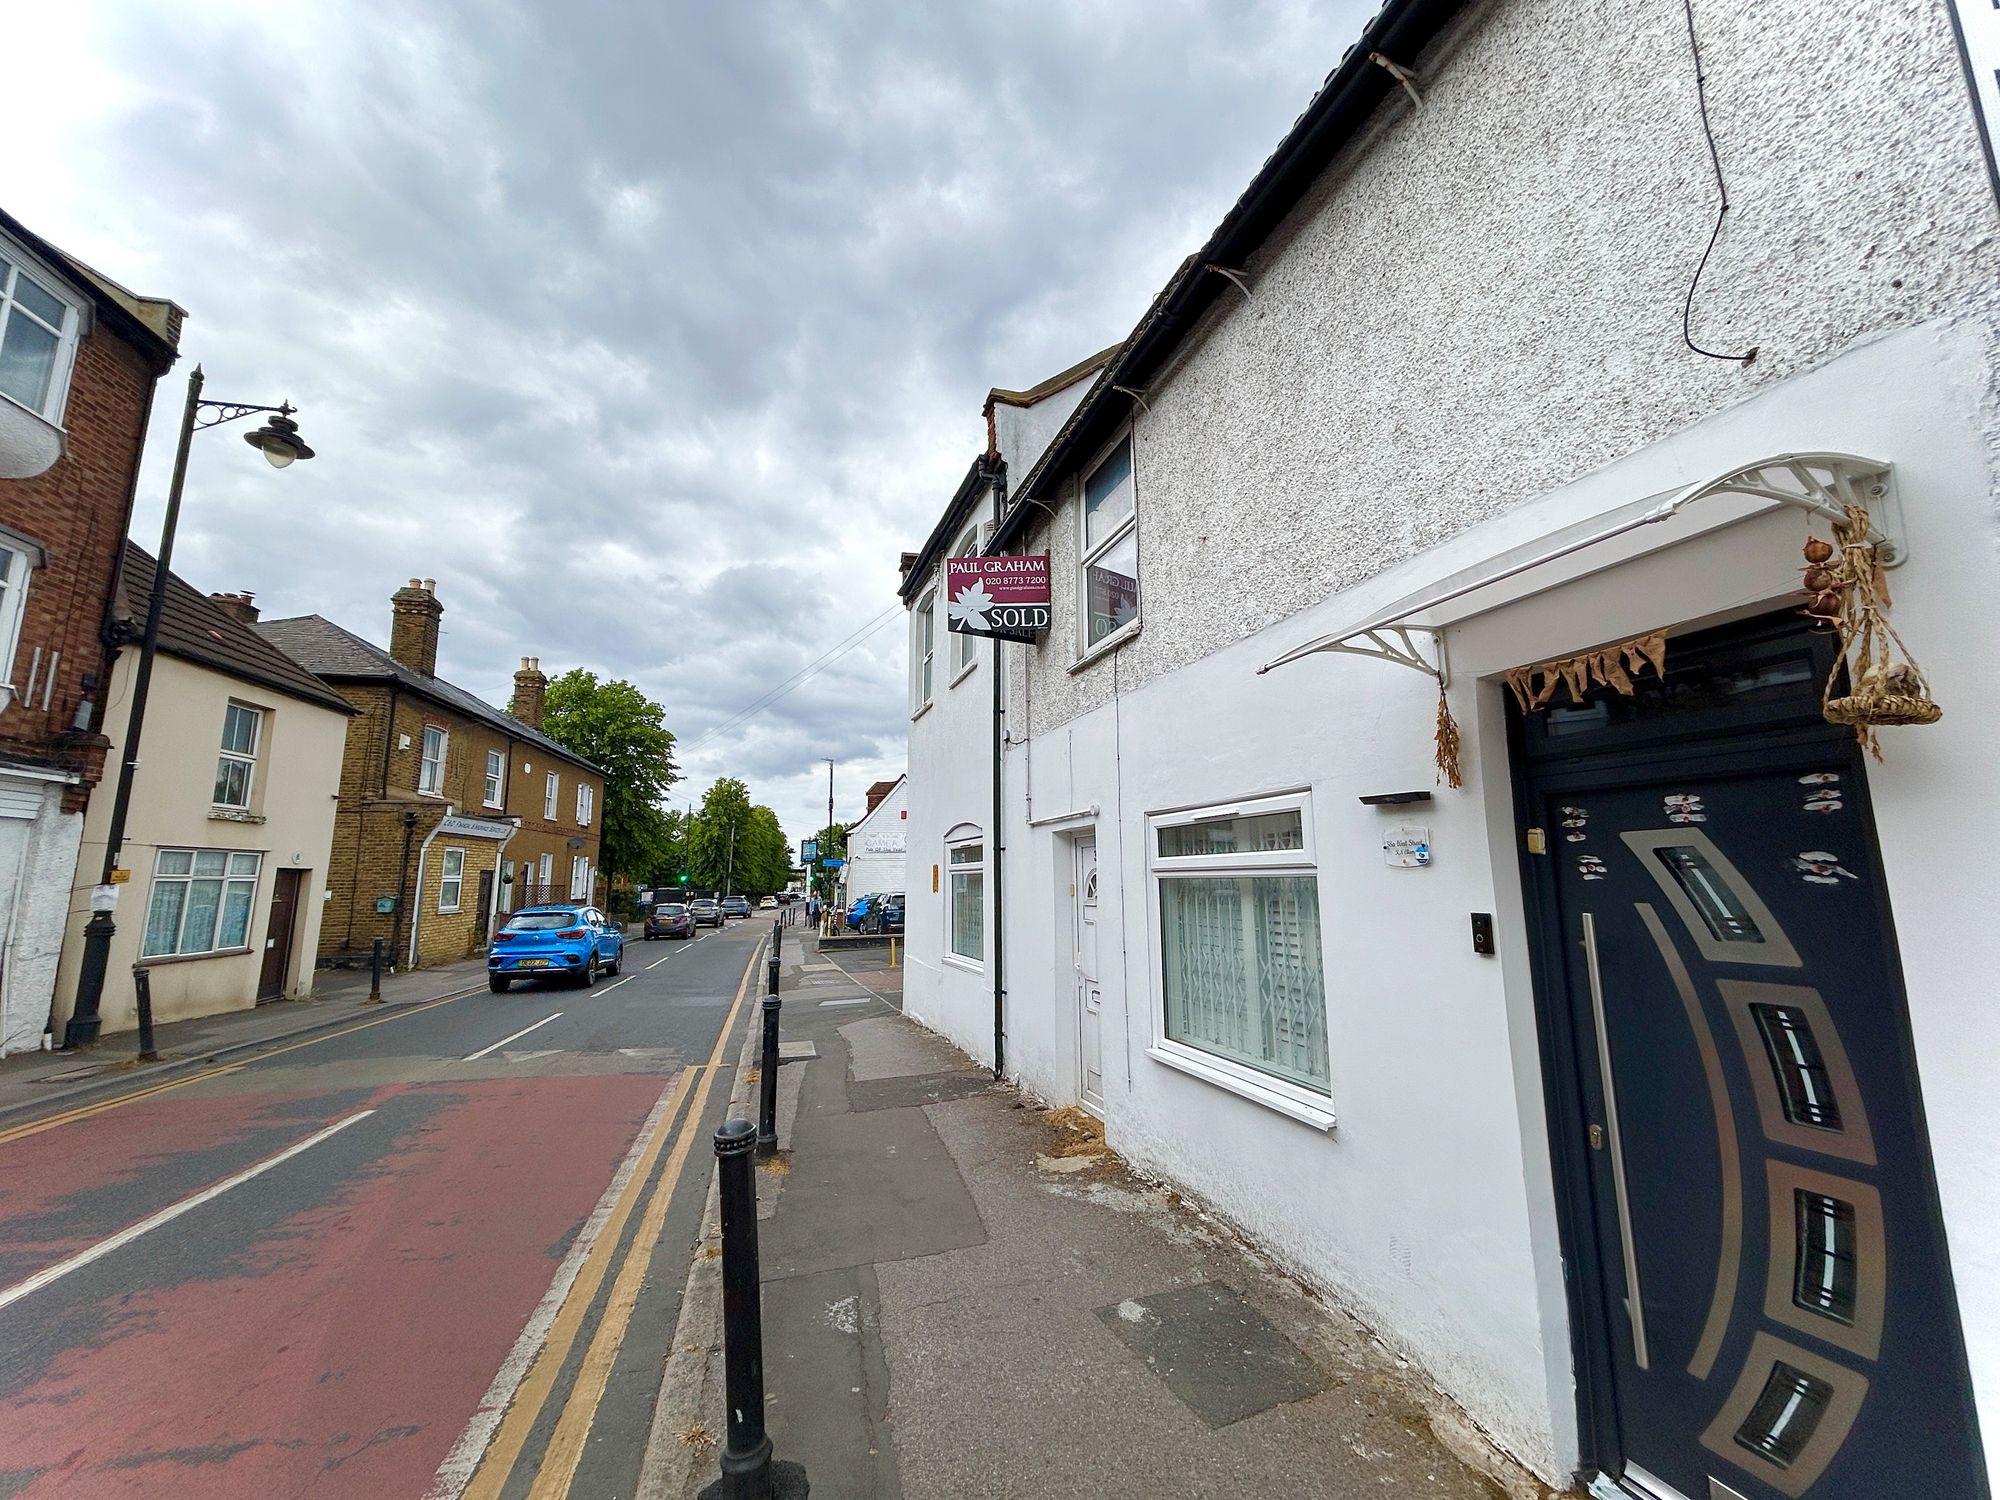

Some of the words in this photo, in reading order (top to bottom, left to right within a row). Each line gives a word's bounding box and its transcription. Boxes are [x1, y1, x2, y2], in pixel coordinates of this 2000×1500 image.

[949, 562, 981, 575] PAUL
[984, 561, 1045, 573] GRAHAM
[985, 577, 1002, 585] 020
[1003, 577, 1023, 585] 8773
[1026, 576, 1046, 584] 7200
[991, 608, 1048, 628] SOLD
